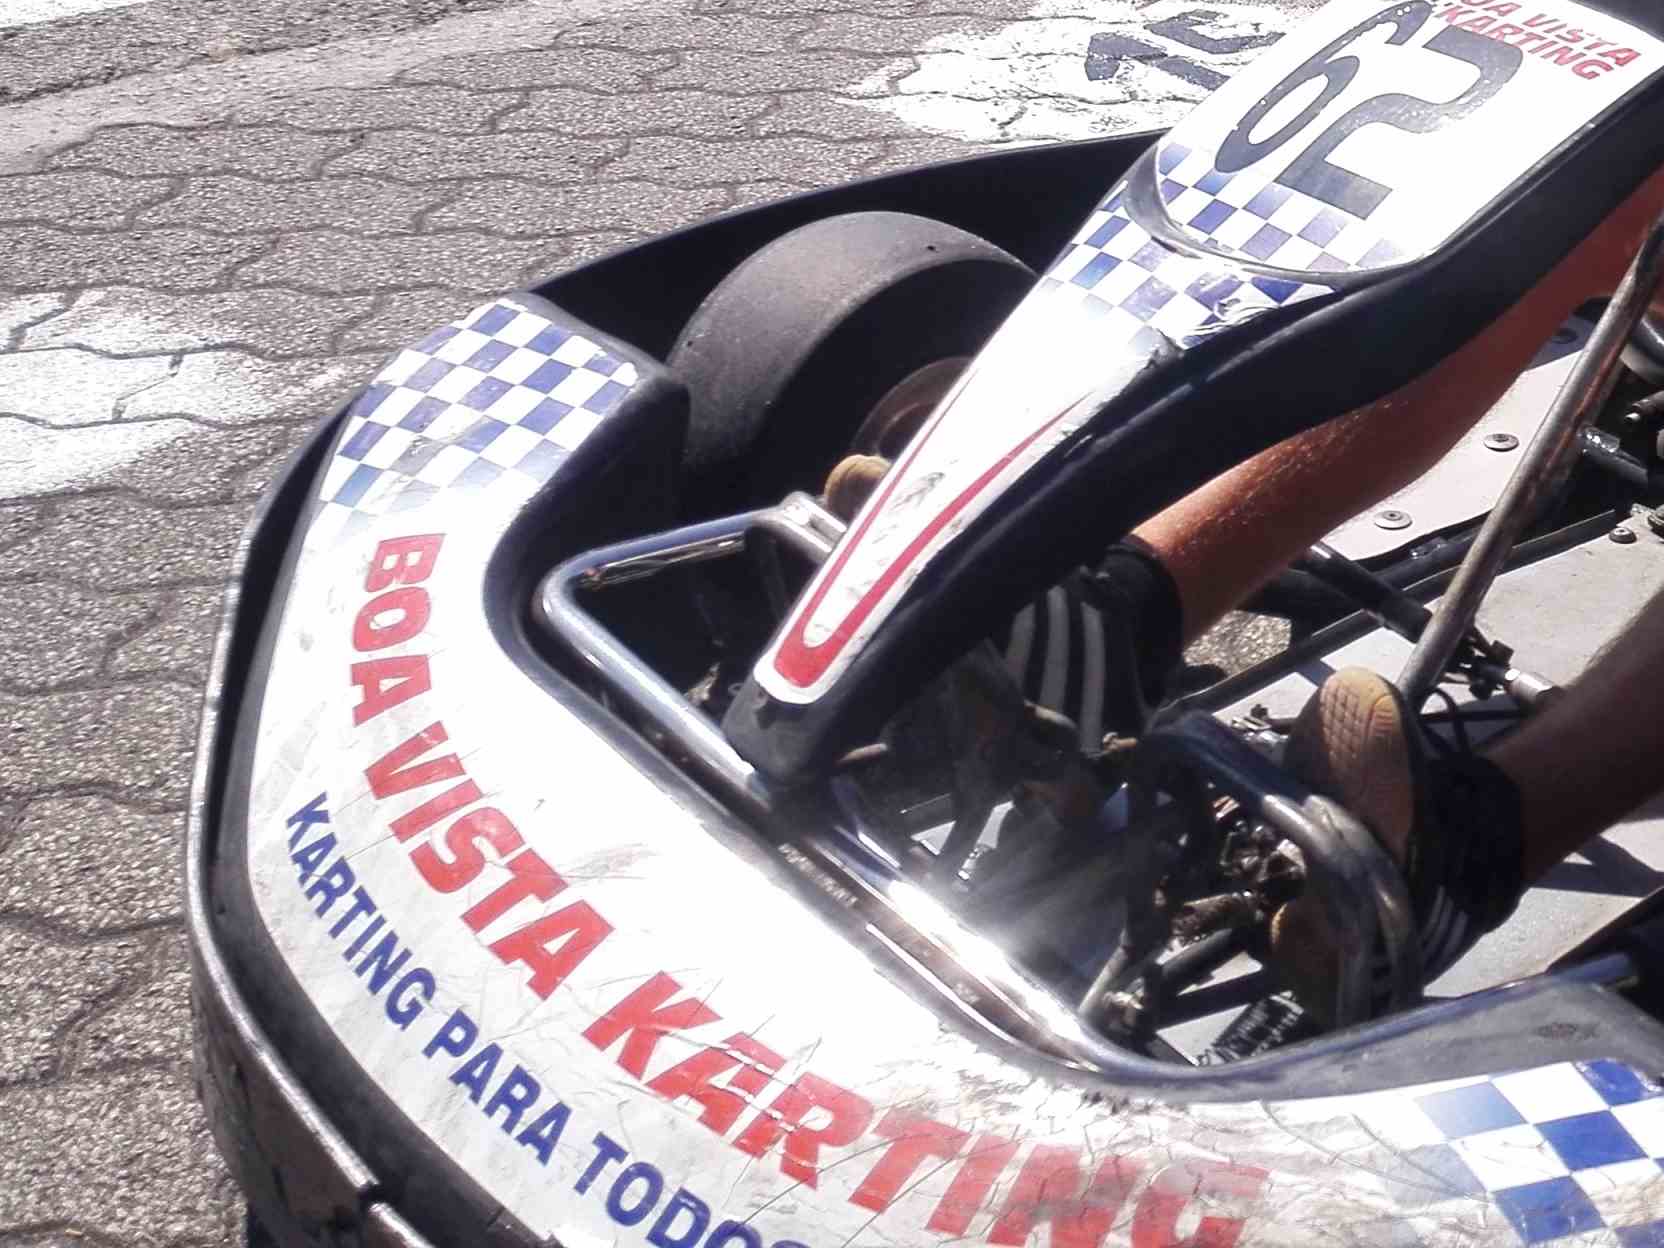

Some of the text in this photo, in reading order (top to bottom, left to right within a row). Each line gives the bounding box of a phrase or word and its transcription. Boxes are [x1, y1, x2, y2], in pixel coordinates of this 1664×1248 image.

[1214, 0, 1523, 221] 62
[1434, 5, 1615, 81] KARTING
[1522, 13, 1642, 67] VISTA
[285, 791, 437, 1032] KARTING
[422, 1007, 574, 1167] PARA
[350, 532, 1272, 1248] BOA VISTA KARTING
